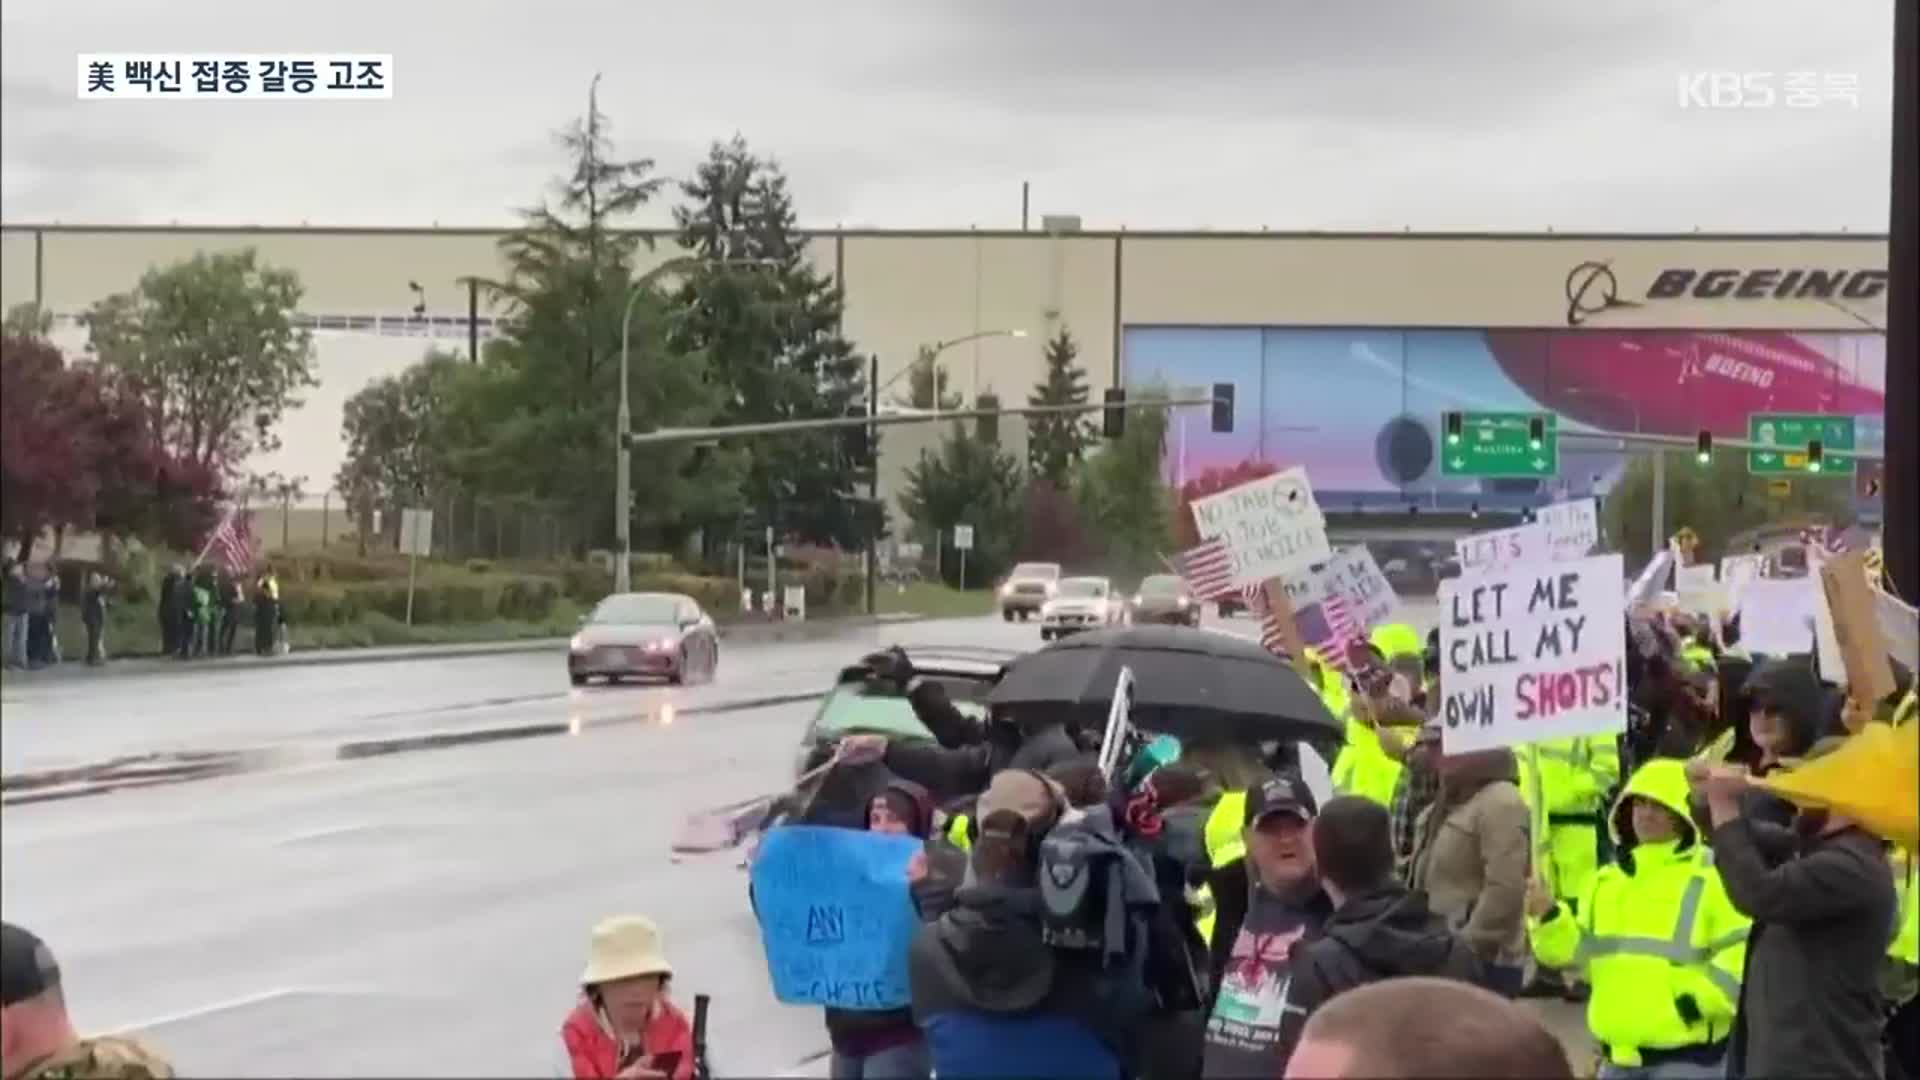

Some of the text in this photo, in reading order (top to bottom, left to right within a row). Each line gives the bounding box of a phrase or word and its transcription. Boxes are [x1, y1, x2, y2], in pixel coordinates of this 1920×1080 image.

[1646, 268, 1888, 300] BOEING
[1703, 351, 1776, 390] BOEING
[1452, 573, 1580, 627] LET ME
[1450, 615, 1587, 673] CALL MY
[1446, 658, 1622, 728] OWN SHOTS!
[806, 903, 845, 943] ANY
